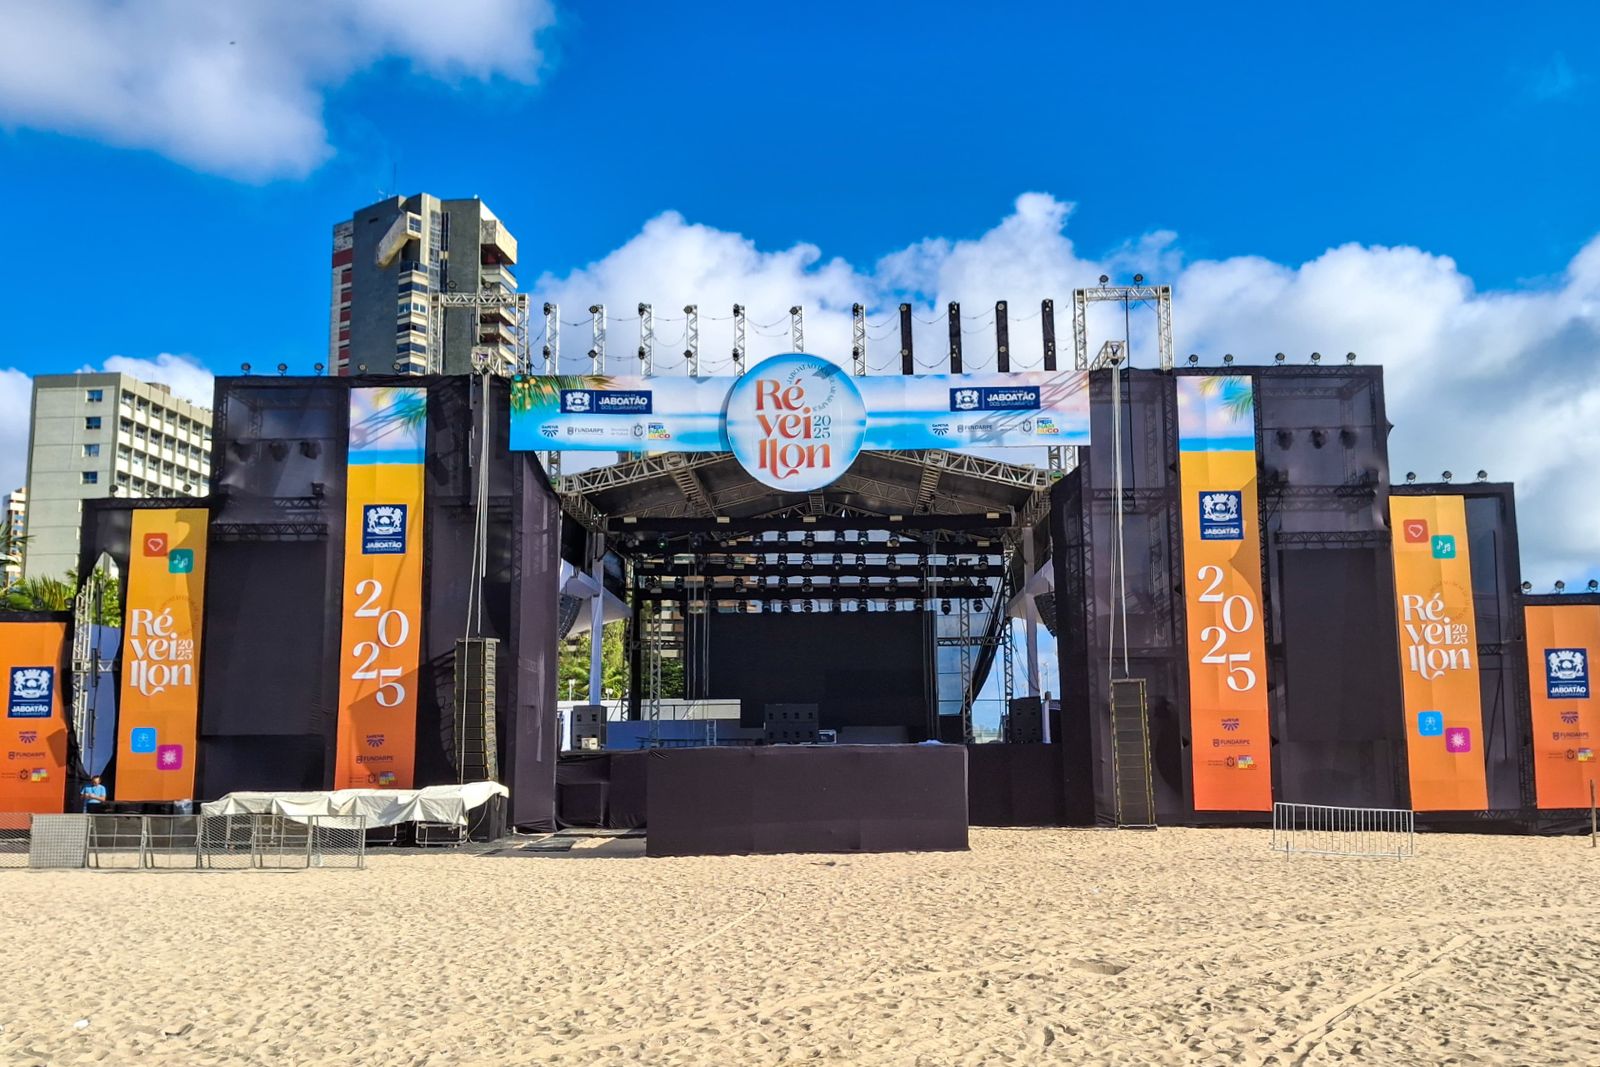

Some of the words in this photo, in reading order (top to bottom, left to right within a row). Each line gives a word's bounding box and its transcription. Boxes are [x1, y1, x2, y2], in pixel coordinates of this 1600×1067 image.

[755, 378, 806, 411] Ré
[986, 391, 1036, 402] JABOATÃO
[598, 395, 648, 406] JABOATÃO
[756, 406, 812, 439] vei
[813, 415, 832, 427] 20
[813, 427, 831, 439] 25
[1203, 526, 1240, 535] JABOATÃO
[365, 540, 402, 549] JABOATÃO
[1402, 592, 1445, 622] Ré
[130, 607, 174, 637] Ré
[1404, 616, 1452, 645] vei
[1452, 623, 1468, 634] 20
[177, 639, 194, 650] 20
[1453, 634, 1469, 645] 25
[129, 632, 178, 660] vei
[177, 650, 193, 660] 25
[1550, 685, 1587, 693] JABOATÃO
[11, 704, 49, 713] JABOATÃO
